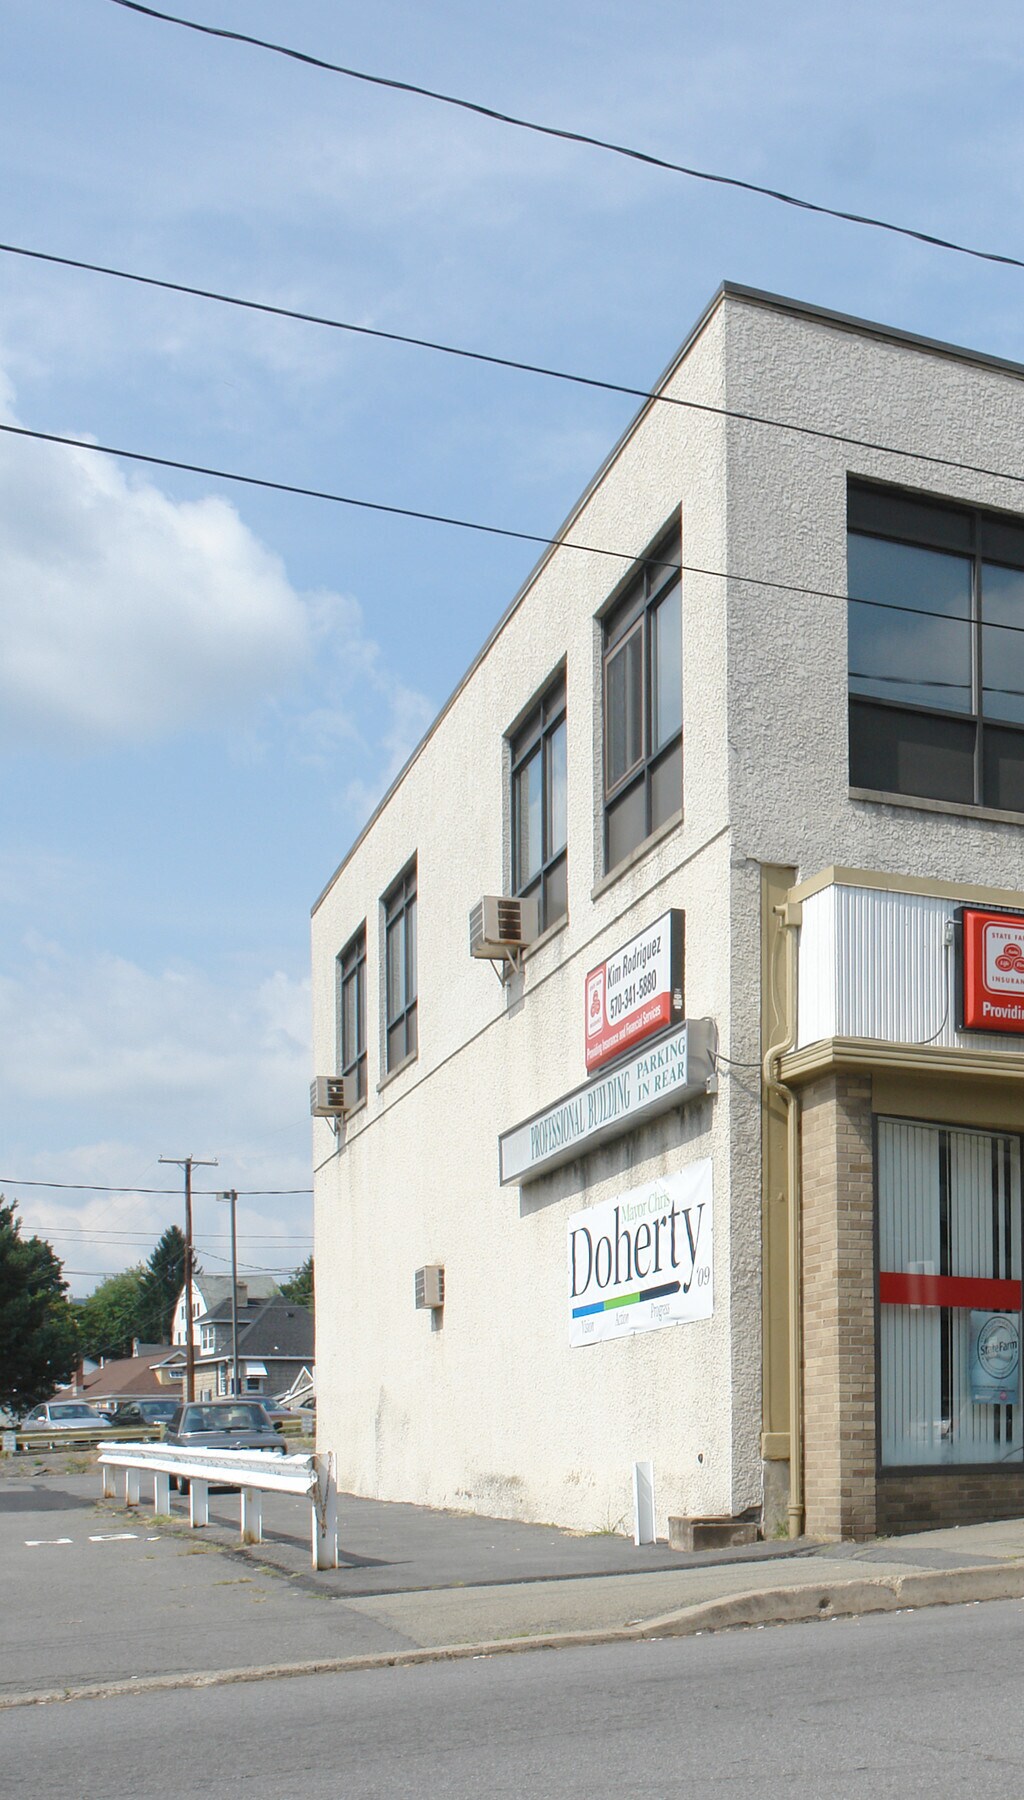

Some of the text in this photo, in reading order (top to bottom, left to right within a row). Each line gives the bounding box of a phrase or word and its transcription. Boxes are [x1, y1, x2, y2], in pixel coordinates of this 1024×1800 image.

[992, 932, 1011, 940] STATE
[607, 935, 661, 990] Kim Rodriguez
[610, 969, 657, 1020] 570-341-5880
[643, 1004, 661, 1026] Services
[636, 1036, 686, 1080] PARKING
[637, 1061, 686, 1102] IN REAR
[530, 1070, 631, 1161] PROFESSIONAL BUILDING
[620, 1189, 671, 1225] Mayor Chris
[569, 1199, 706, 1299] Doherty
[615, 1311, 630, 1326] Action
[650, 1302, 671, 1321] Progress
